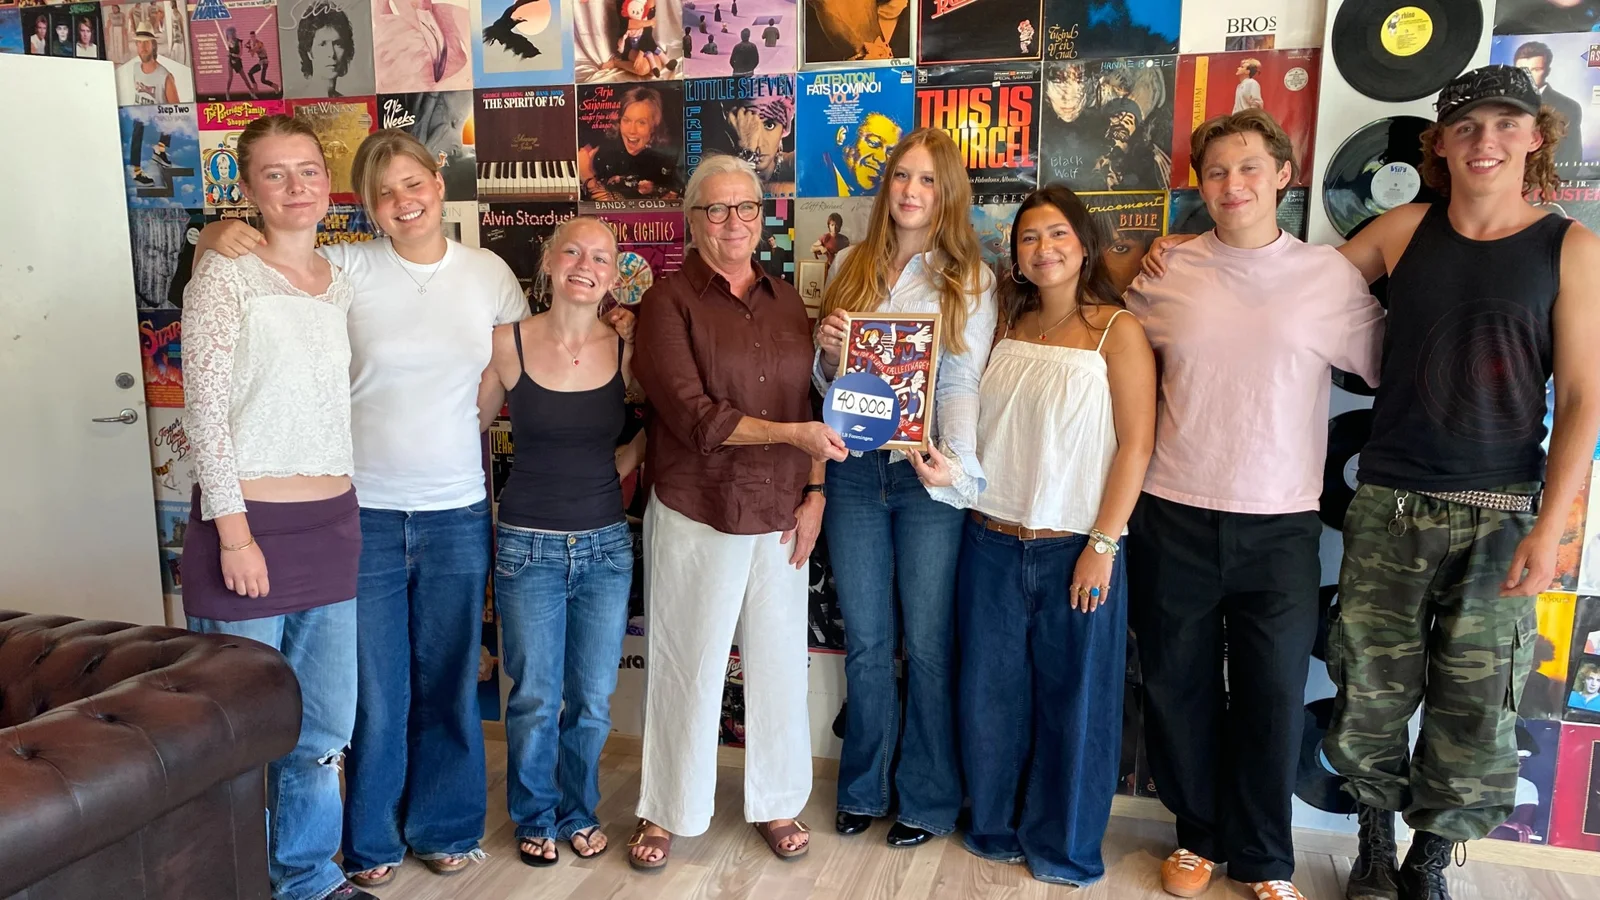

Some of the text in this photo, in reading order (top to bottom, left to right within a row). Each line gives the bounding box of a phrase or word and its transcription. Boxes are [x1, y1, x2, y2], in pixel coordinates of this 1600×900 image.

[814, 72, 876, 86] ATTENTION!
[594, 87, 614, 102] Arja
[685, 74, 794, 101] LITTLE STEVEN
[806, 81, 882, 95] FATS DOMINO!
[483, 94, 565, 109] THE SPIRIT OF 176
[917, 85, 1033, 129] THIS IS
[1194, 88, 1203, 120] ALBUM
[158, 105, 190, 115] Step Two
[302, 105, 319, 115] THE
[383, 112, 416, 129] Weeks
[943, 126, 1034, 169] URCEL
[1050, 155, 1083, 168] Black
[1054, 167, 1078, 179] Wolf
[595, 201, 626, 209] BANDS
[638, 200, 666, 208] GOLD
[970, 194, 1025, 204] EE GEES
[1086, 196, 1165, 214] oucement
[482, 210, 576, 226] Alvin Stardust
[633, 221, 675, 242] EIGHTIES
[491, 430, 508, 442] TOM
